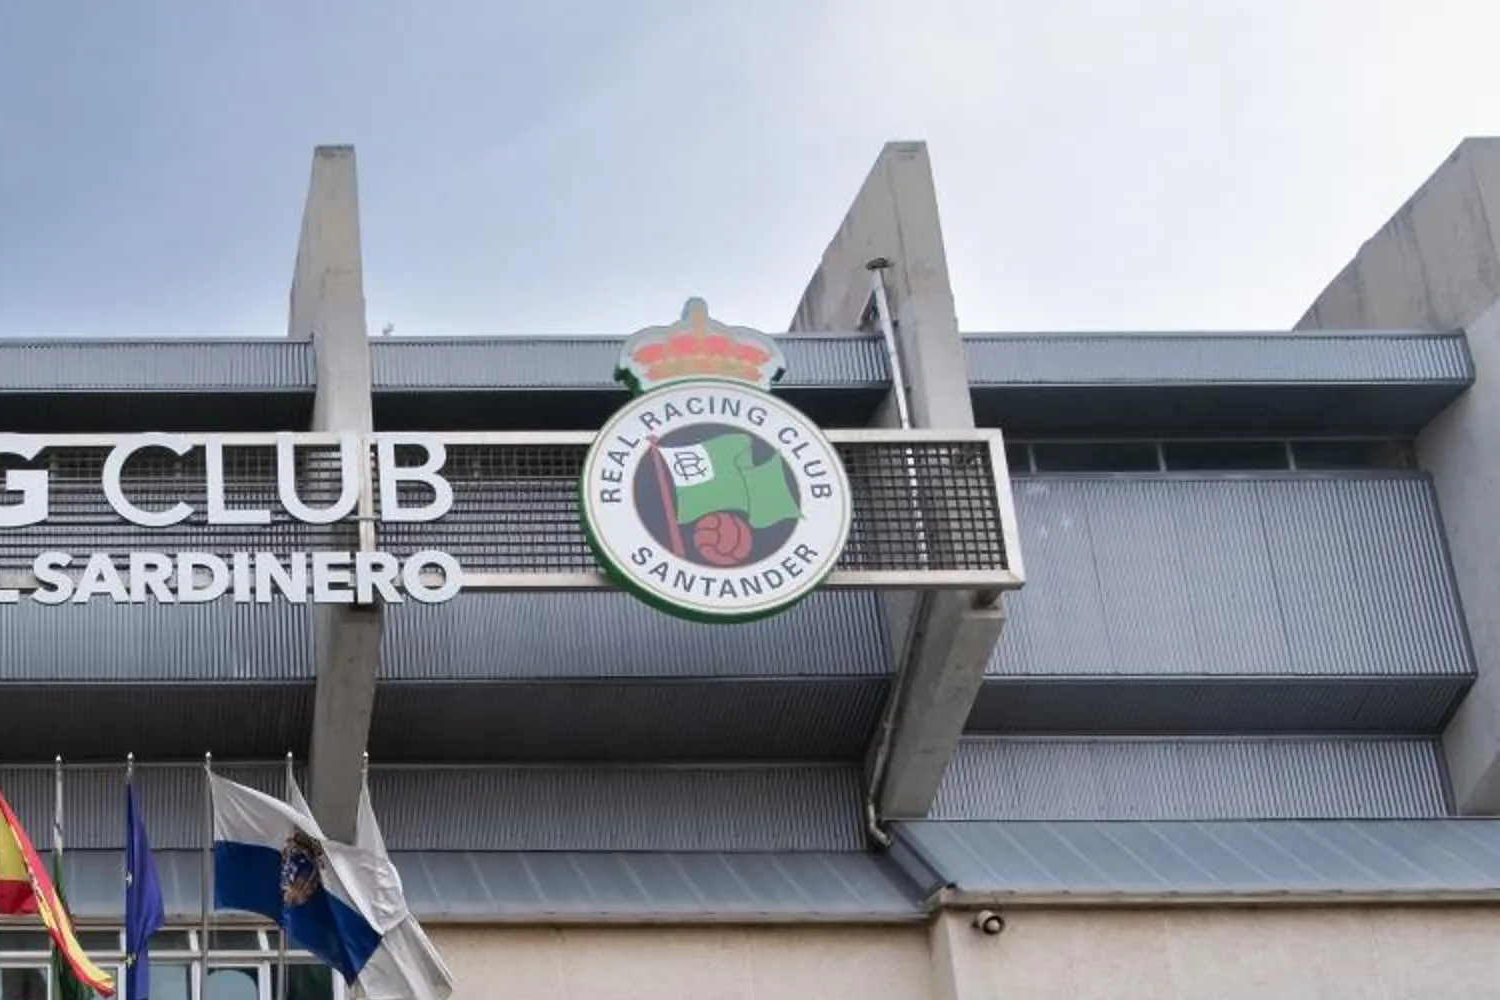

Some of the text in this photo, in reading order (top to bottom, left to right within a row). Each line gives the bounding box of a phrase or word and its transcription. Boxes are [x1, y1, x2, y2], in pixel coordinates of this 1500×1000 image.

[101, 430, 455, 525] CLUB
[601, 435, 641, 504] REAL
[639, 396, 768, 431] RACING
[776, 426, 833, 502] CLUB
[31, 549, 466, 605] SARDINERO
[630, 541, 820, 600] SANTANDER
